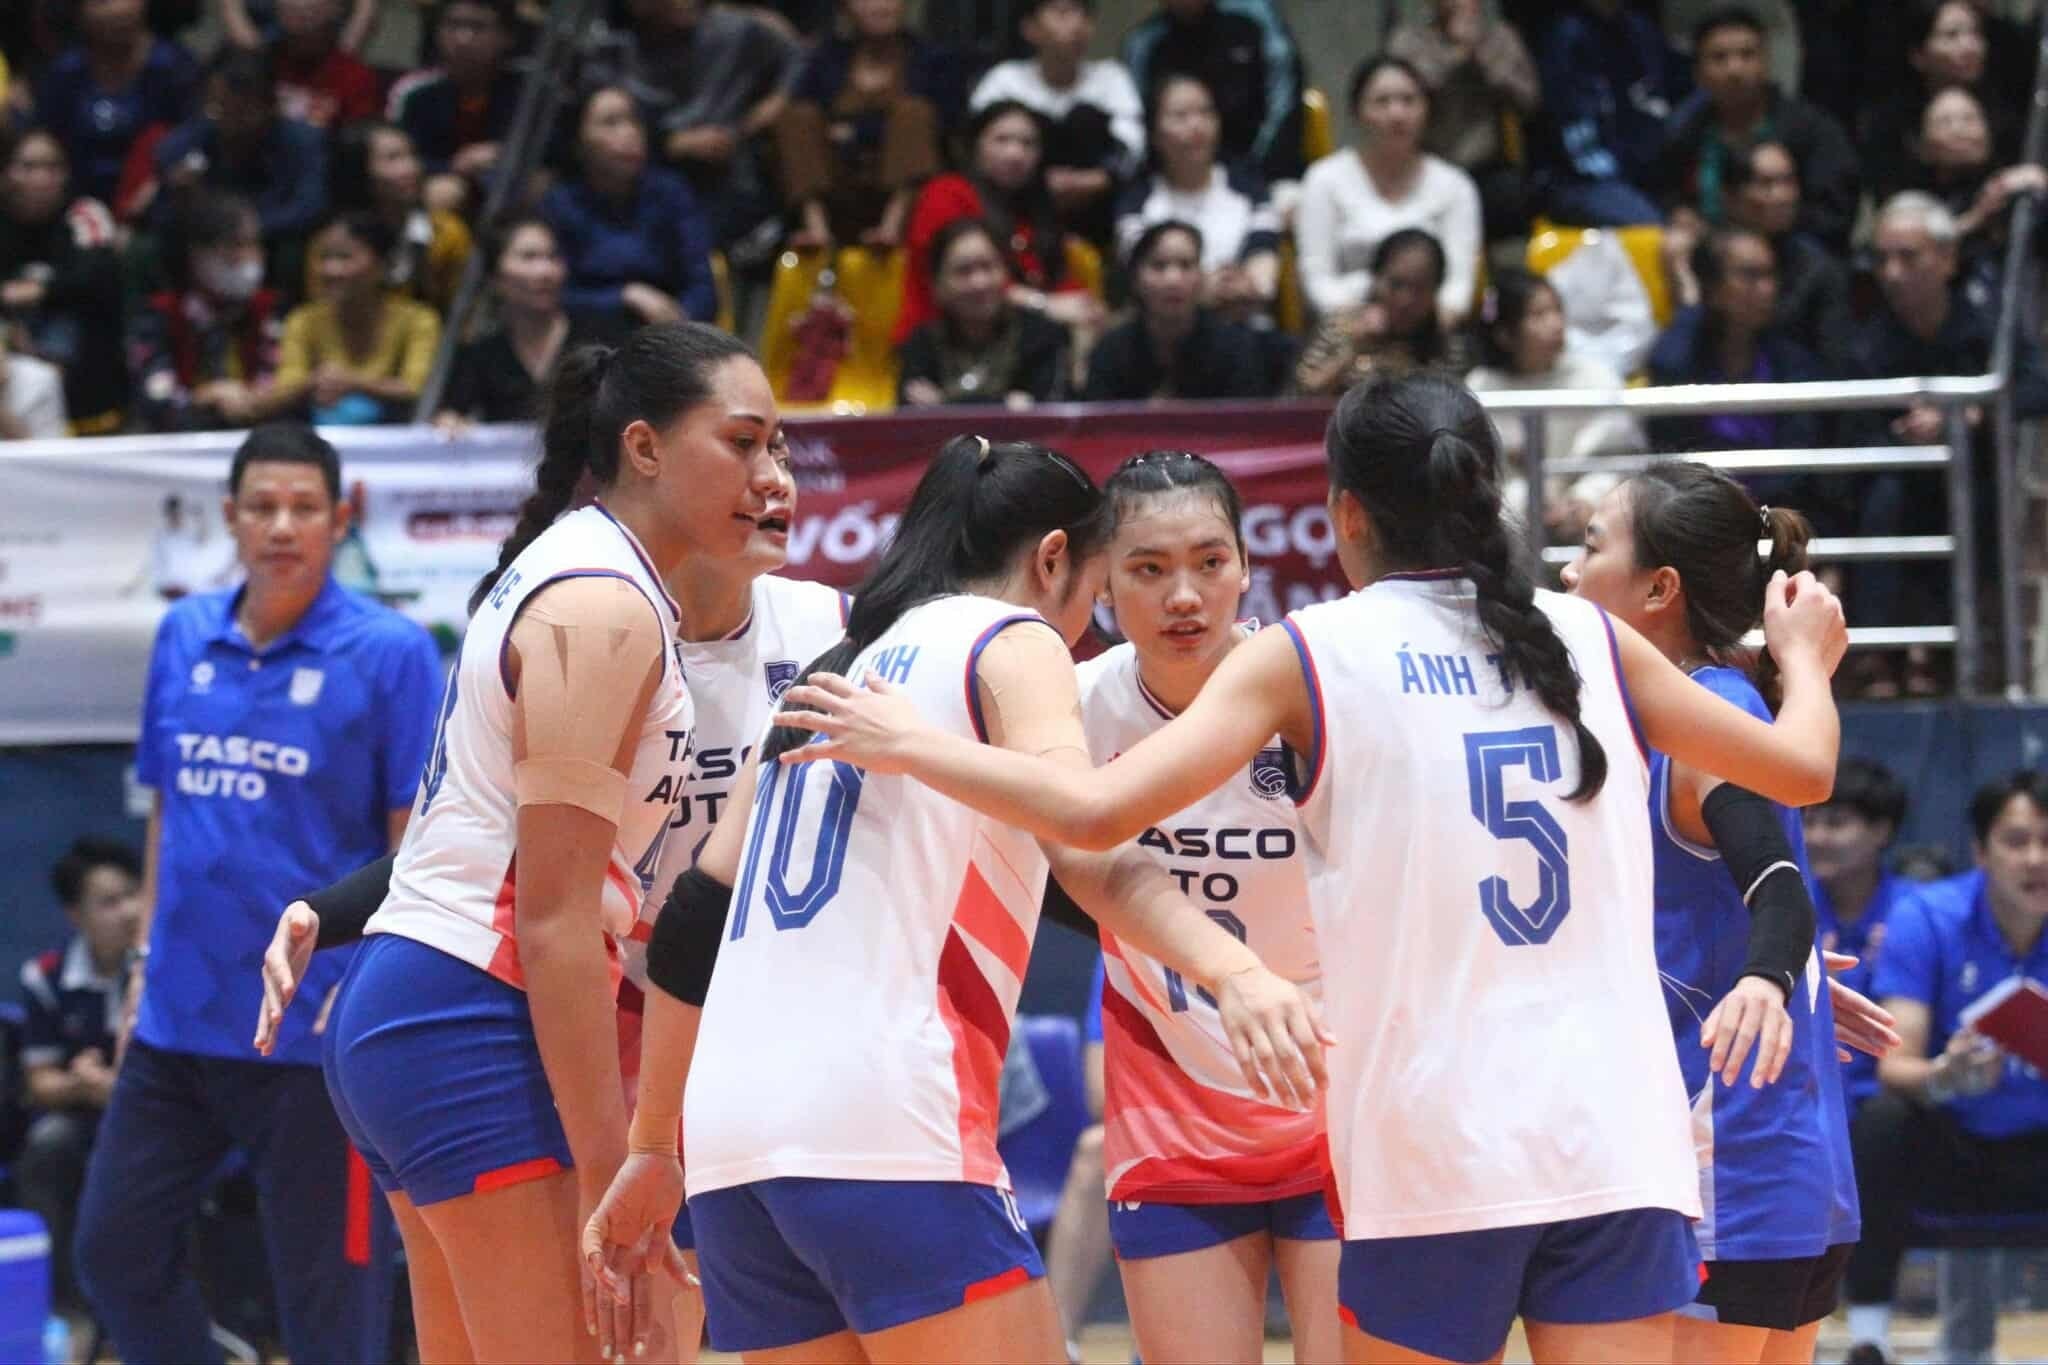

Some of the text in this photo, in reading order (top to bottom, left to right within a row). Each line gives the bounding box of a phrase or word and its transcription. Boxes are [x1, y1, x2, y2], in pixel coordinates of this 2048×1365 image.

[1396, 642, 1477, 695] ÁNH
[175, 732, 310, 777] TASCO
[729, 732, 866, 942] 10
[1136, 826, 1296, 860] ASCO
[1462, 724, 1571, 947] 5
[1169, 868, 1239, 902] TO
